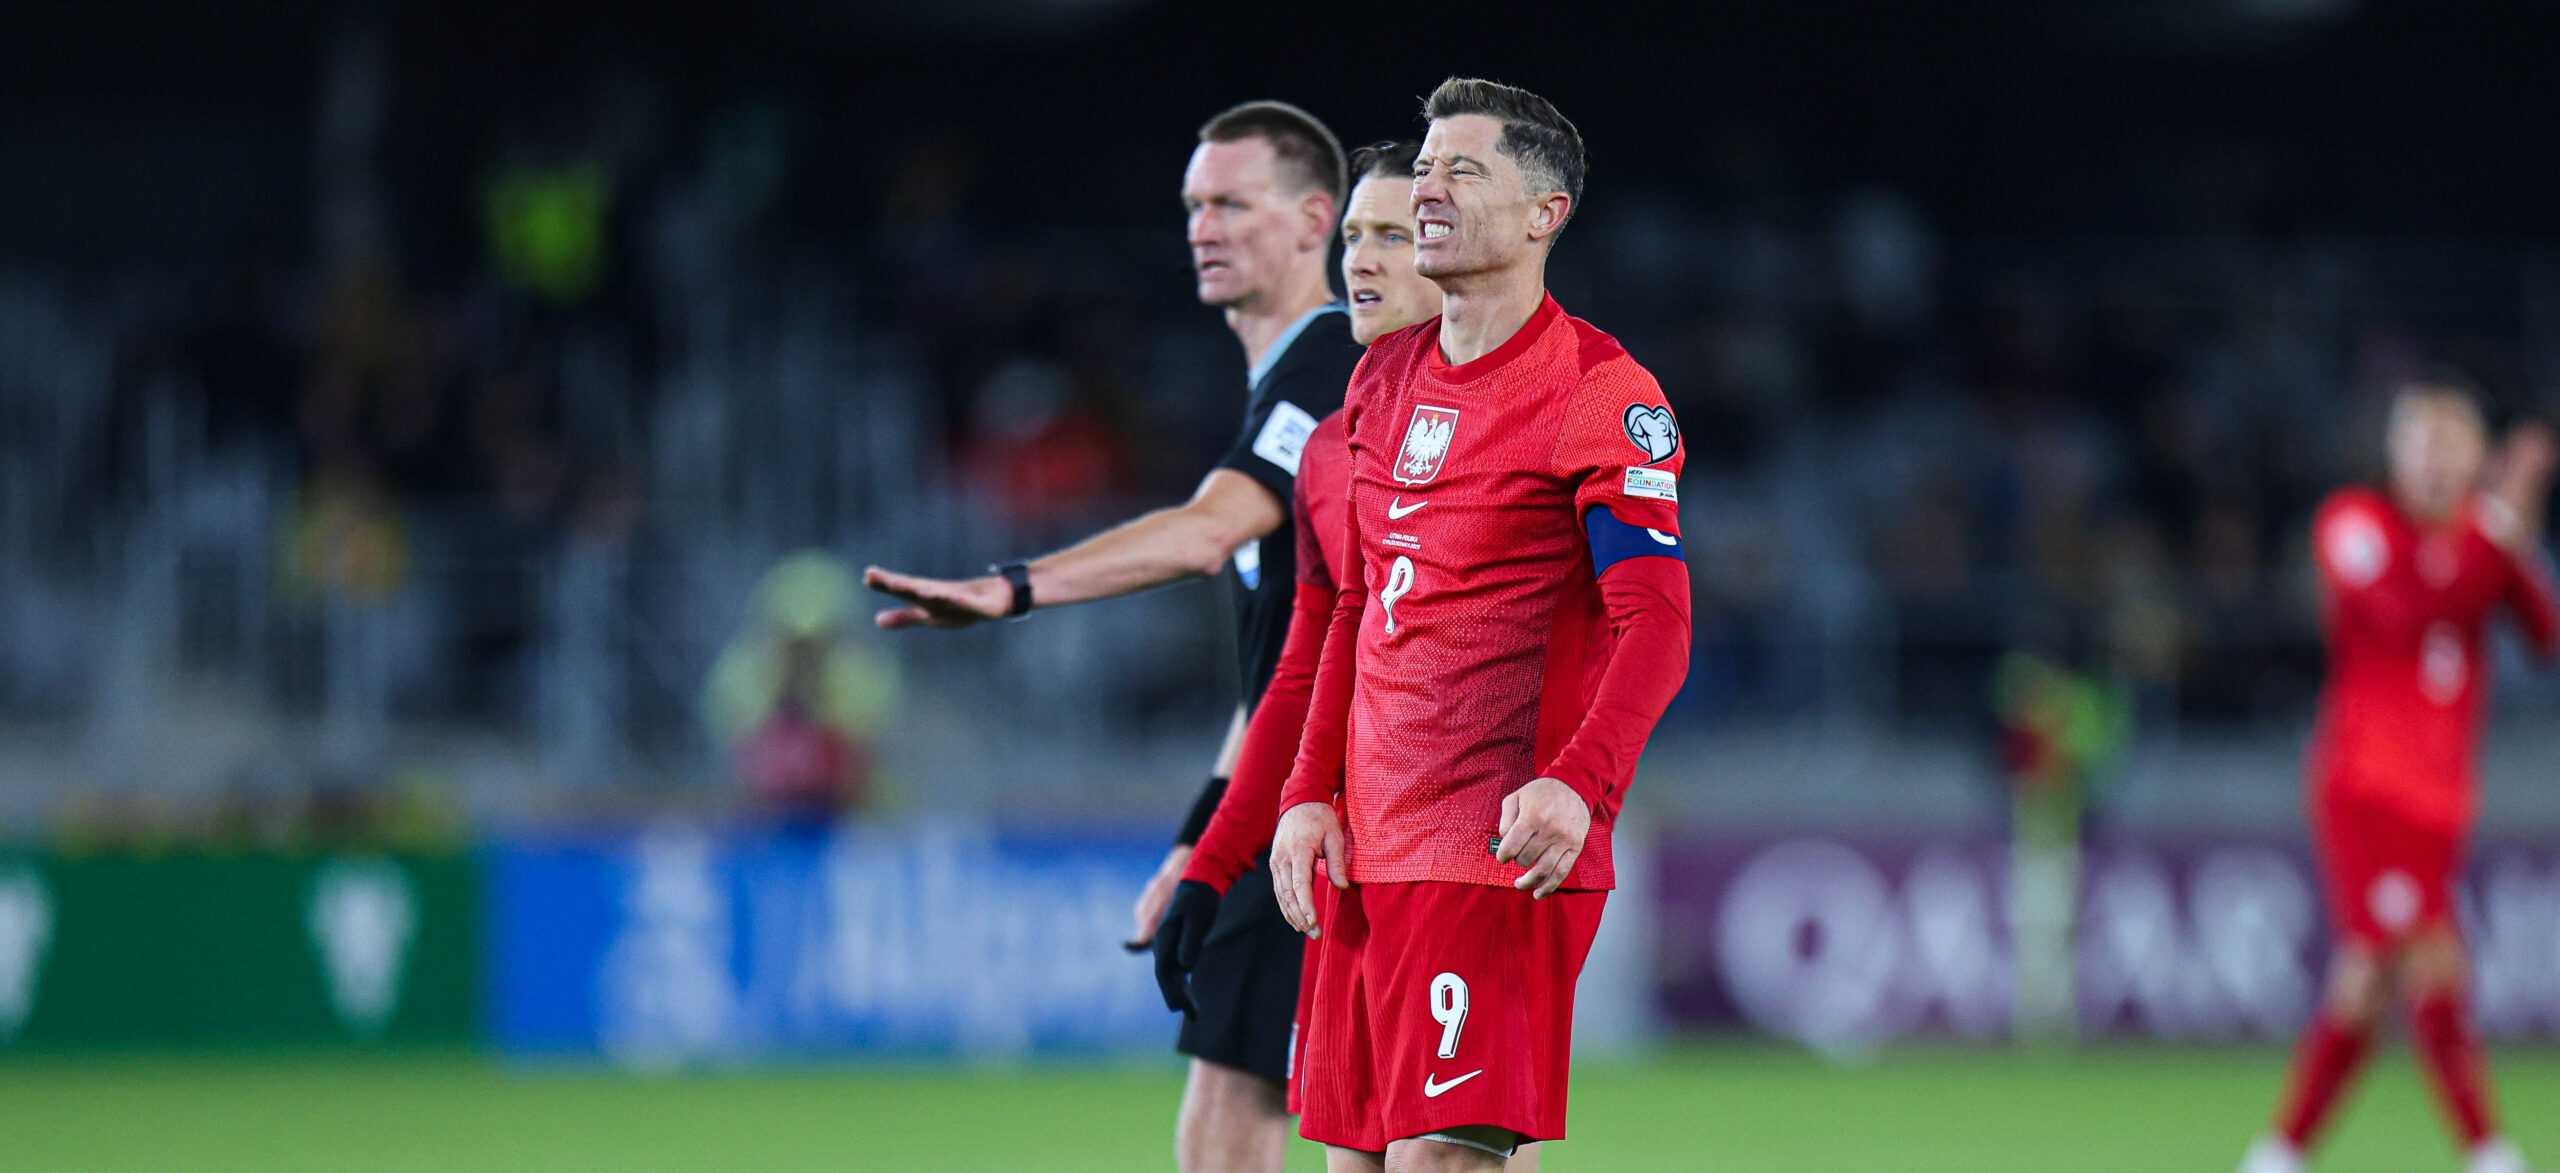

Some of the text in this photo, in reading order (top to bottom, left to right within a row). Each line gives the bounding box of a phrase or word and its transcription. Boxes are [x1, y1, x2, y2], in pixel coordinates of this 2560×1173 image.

[1627, 477, 1674, 490] FOUNDATION
[1380, 555, 1415, 634] 9
[1430, 972, 1469, 1059] 9
